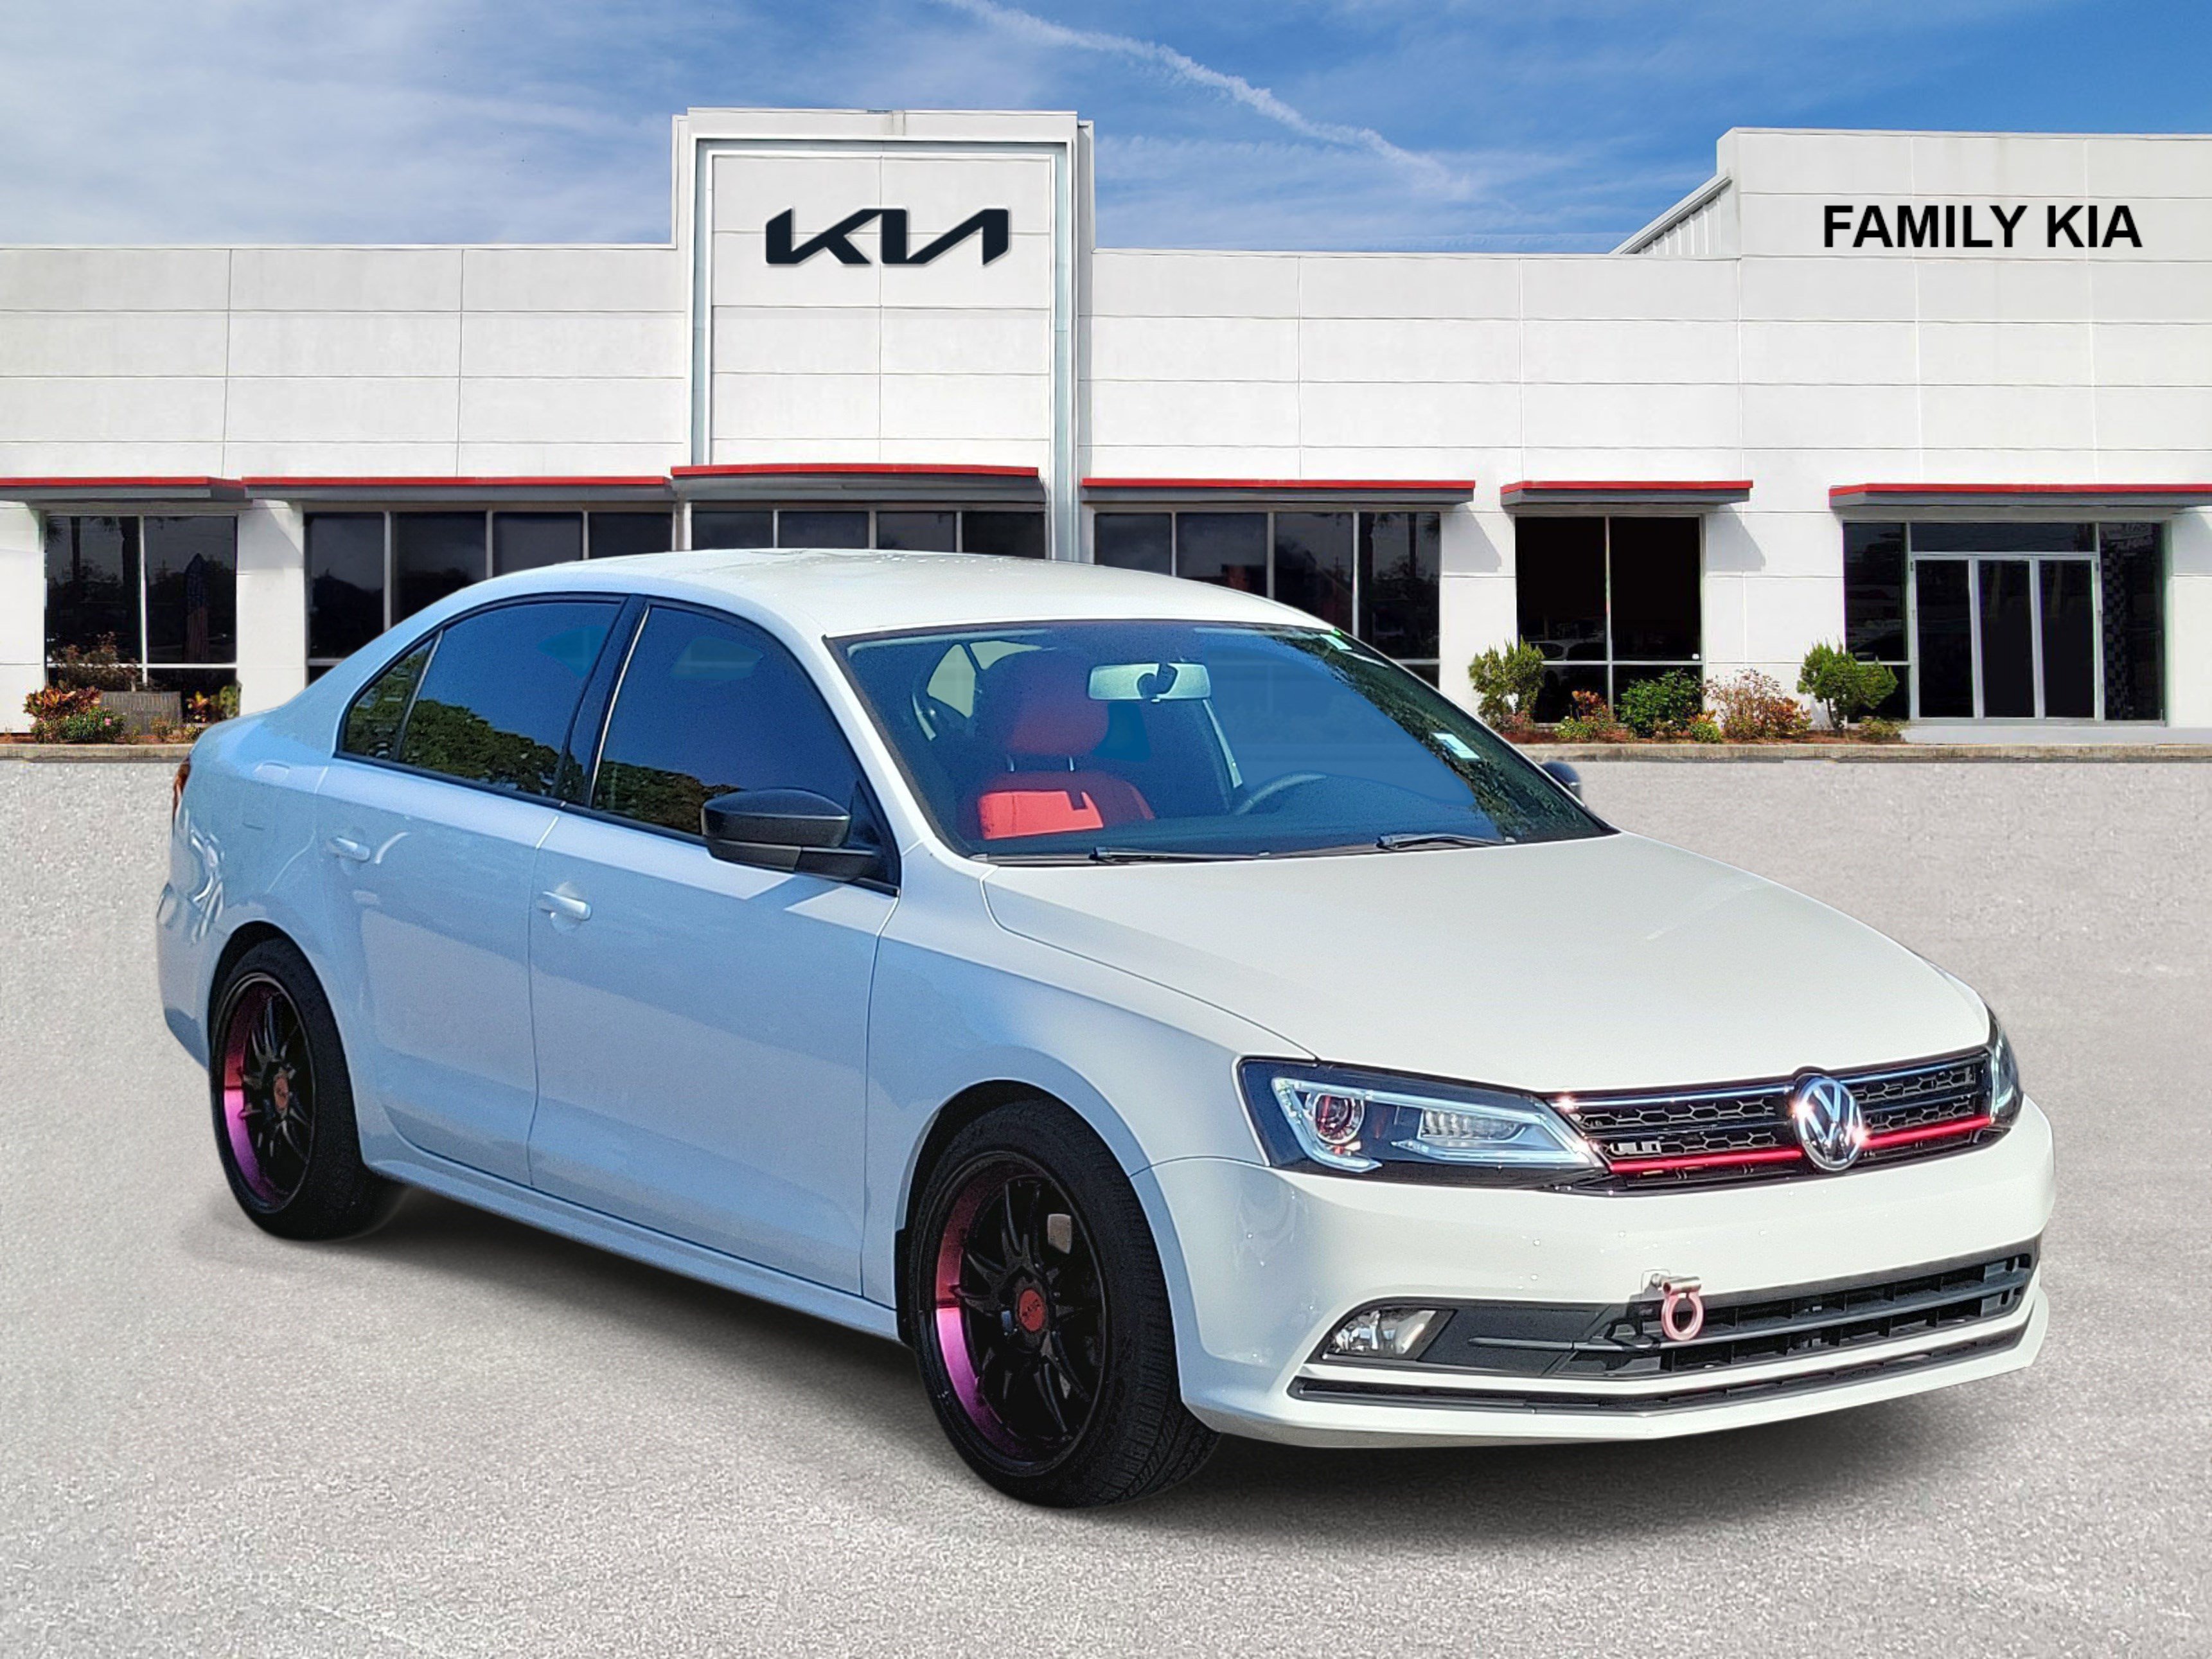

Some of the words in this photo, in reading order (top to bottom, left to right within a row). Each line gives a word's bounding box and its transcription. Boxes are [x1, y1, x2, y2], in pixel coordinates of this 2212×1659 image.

[765, 208, 1009, 265] KIA
[1823, 204, 2028, 248] FAMILY
[2046, 204, 2143, 248] KIA
